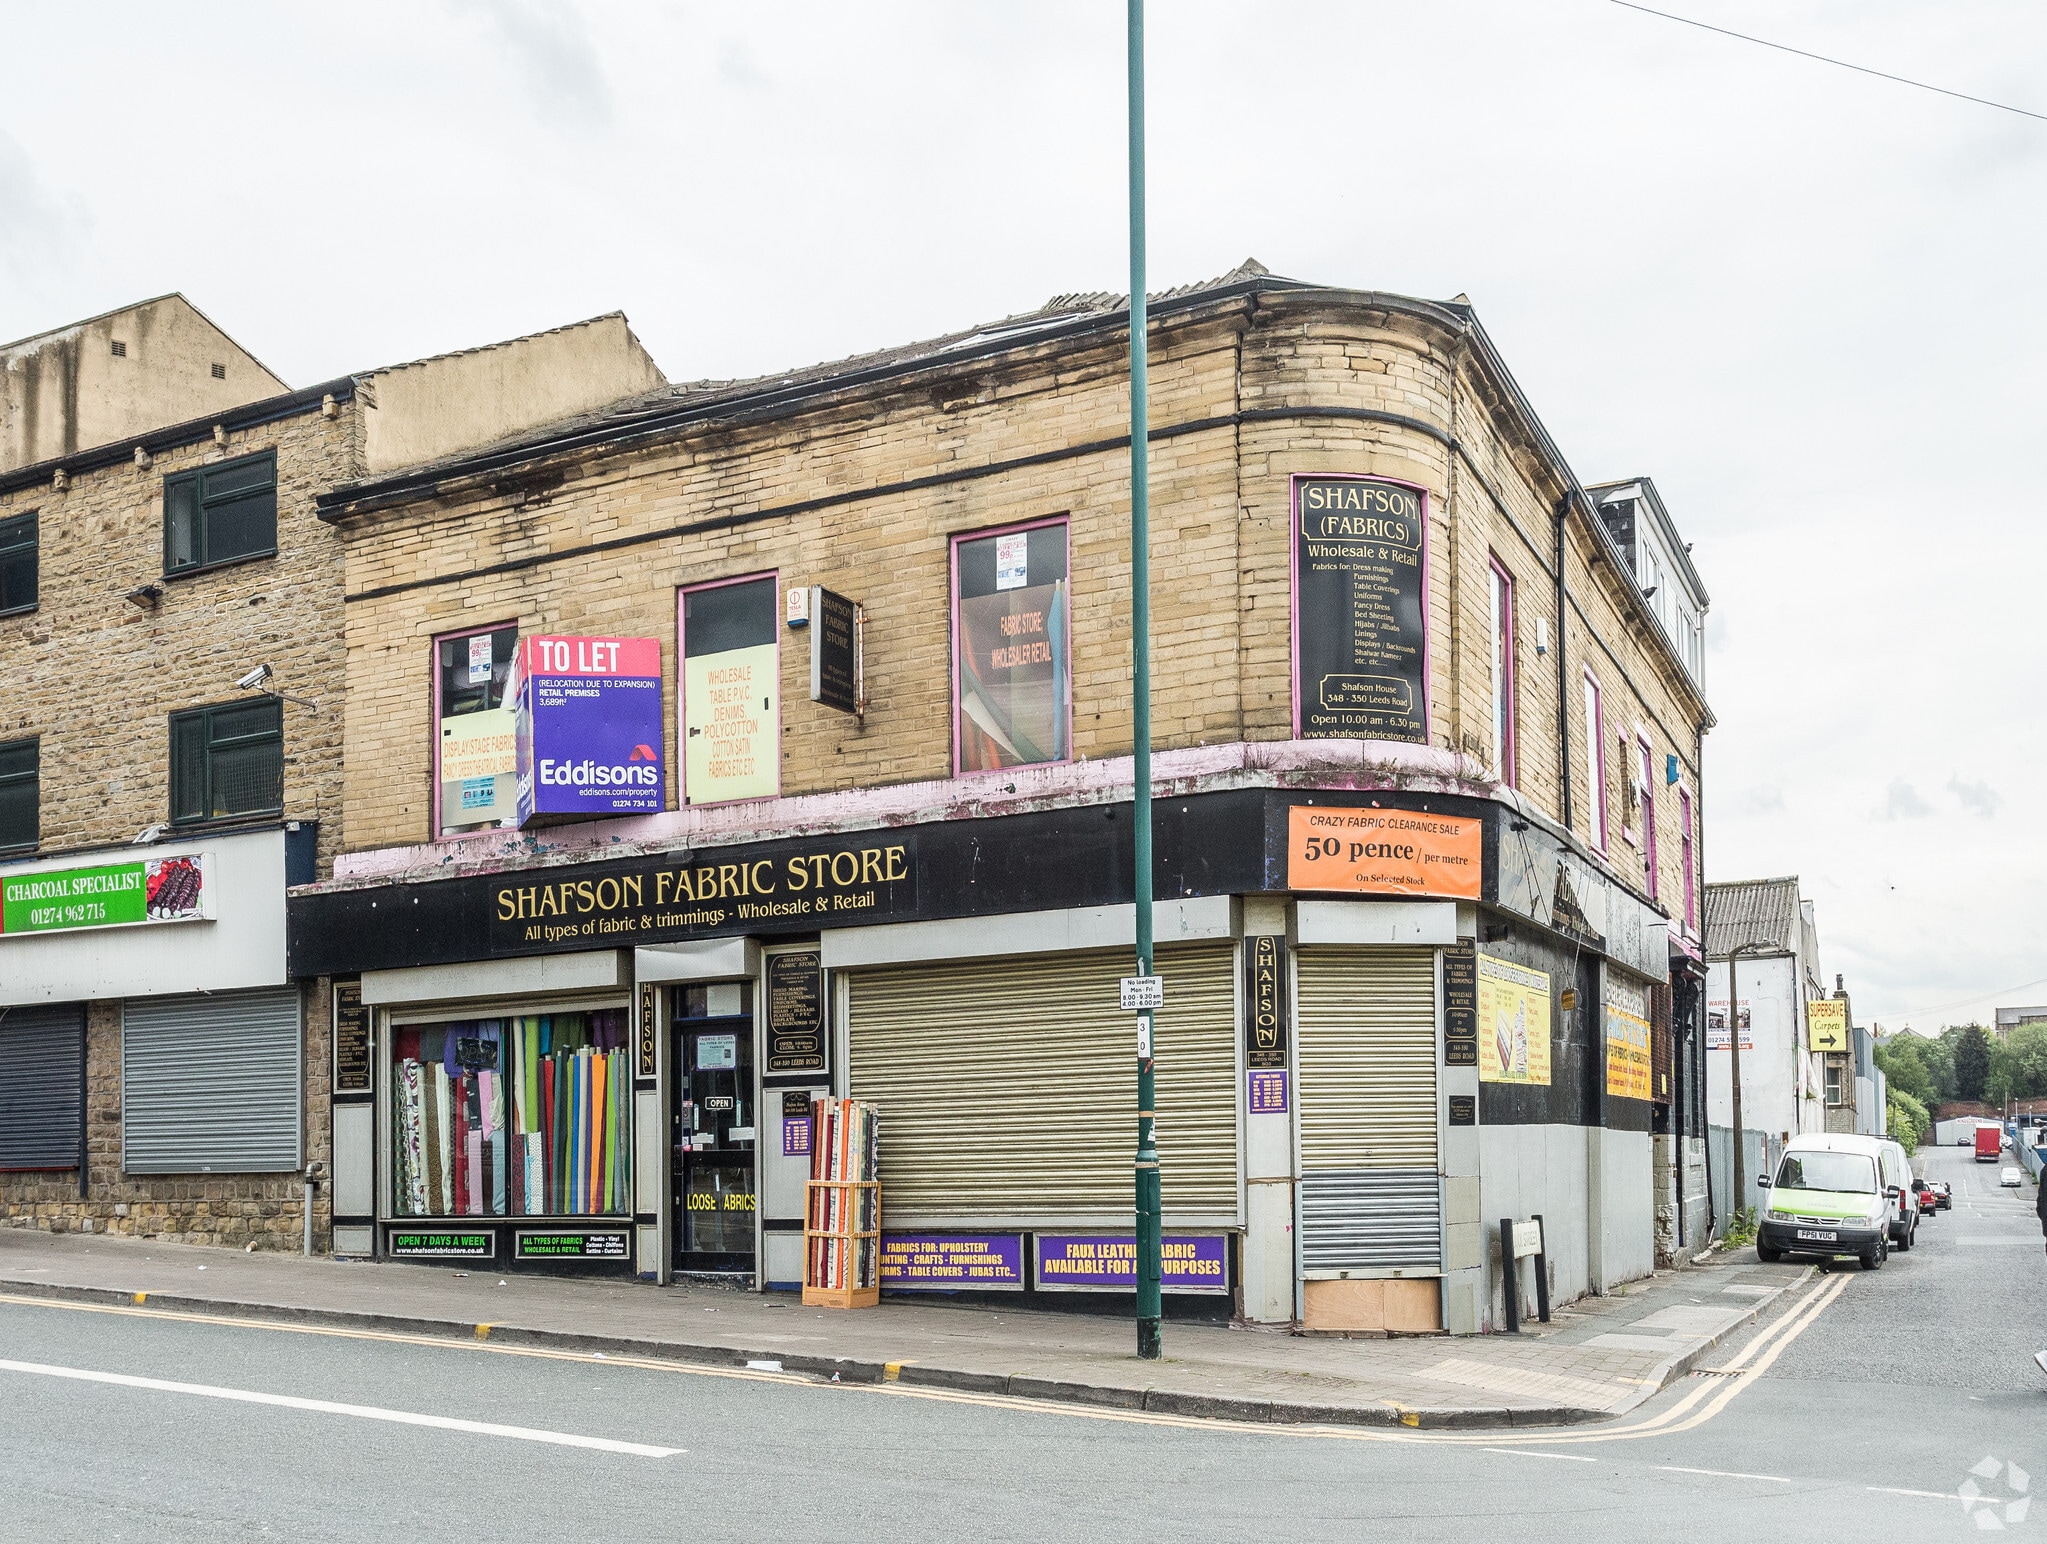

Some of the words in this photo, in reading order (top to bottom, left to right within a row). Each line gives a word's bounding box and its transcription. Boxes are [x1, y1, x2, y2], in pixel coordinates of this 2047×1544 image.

[1308, 487, 1417, 520] SHAFSON
[1320, 516, 1410, 545] (FABRICS)
[1307, 545, 1375, 559] Wholesale
[1378, 547, 1388, 560] &
[1391, 550, 1418, 567] Retail
[1352, 563, 1371, 571] Dress
[1372, 565, 1394, 576] making
[1353, 573, 1389, 583] Furnishings
[1353, 592, 1383, 601] Uniforms
[1373, 584, 1400, 595] Coverings
[821, 596, 852, 618] SHAFSON
[1354, 601, 1373, 611] Fancy
[1374, 602, 1391, 611] Dress
[825, 614, 849, 634] FABRIC
[1000, 611, 1022, 637] FABRIC
[1354, 620, 1375, 629] Hijabs
[1369, 612, 1395, 623] Sheeting
[826, 631, 849, 650] STORE
[1354, 630, 1378, 639] Linings
[1354, 639, 1381, 648] Displays
[539, 640, 570, 672] TO
[578, 641, 621, 673] LET
[1031, 641, 1052, 664] RETAIL
[707, 666, 752, 685] WHOLESALE
[538, 679, 584, 688] (RELOCATION
[586, 680, 601, 688] DUE
[603, 680, 613, 688] TO
[614, 681, 656, 689] EXPANSION)
[1341, 683, 1374, 691] Shafson
[1375, 684, 1397, 694] House
[539, 689, 563, 697] RETAIL
[565, 689, 600, 697] PREMISES
[709, 687, 732, 702] TABLE
[732, 686, 752, 701] P.V.C.
[1327, 694, 1344, 702] 348
[1369, 696, 1390, 705] Leeds
[1391, 697, 1408, 707] Road
[704, 719, 759, 740] POLYCOTTON
[1311, 714, 1337, 725] Open
[1341, 714, 1368, 724] 10.00
[1369, 717, 1383, 725] am
[1389, 716, 1408, 727] 6.30
[1408, 720, 1421, 730] pm
[1303, 728, 1427, 744] www.shafsonfabricstore.co.uk
[712, 741, 735, 760] COTTON
[735, 738, 751, 755] SATIN
[540, 759, 658, 785] Eddisons
[708, 760, 732, 779] FABRICS
[732, 759, 744, 776] ETC
[744, 757, 755, 775] ETC
[579, 788, 658, 797] eddisons.com/property
[1310, 815, 1347, 827] CRAZY
[1347, 816, 1385, 829] FABRIC
[1388, 818, 1438, 834] CLEARANCE
[1439, 824, 1460, 836] SALE
[1304, 837, 1341, 861] 50
[1348, 842, 1414, 863] pence
[1424, 853, 1440, 864] per
[1441, 855, 1469, 866] metre
[6, 880, 71, 903] CHARCOAL
[72, 871, 142, 895] SPECIALIST
[497, 874, 643, 922] SHAFSON
[655, 859, 776, 905] FABRIC
[787, 845, 908, 892] STORE
[1355, 873, 1370, 882] On
[1370, 874, 1405, 884] Selected
[1405, 876, 1426, 886] Stock
[31, 905, 63, 925] 01274
[65, 903, 86, 922] 962
[86, 902, 106, 920] 715
[525, 925, 541, 941] All
[545, 922, 578, 942] types
[581, 918, 596, 936] of
[599, 915, 637, 934] fabric
[640, 915, 653, 929] &
[656, 908, 725, 928] trimmings
[737, 897, 811, 920] Wholesale
[814, 896, 829, 912] &
[834, 891, 875, 910] Retail
[1454, 963, 1467, 971] TYPES
[1258, 939, 1275, 1041] SHAFSON
[1809, 1003, 1844, 1018] SUPERSAVE
[643, 982, 652, 1067] HAFSON
[1814, 1019, 1841, 1031] Carpets
[710, 1099, 729, 1108] OPEN
[687, 1193, 717, 1211] LOOSE
[398, 1236, 421, 1246] OPEN
[422, 1236, 428, 1246] 7
[429, 1236, 451, 1246] DAYS
[452, 1236, 459, 1246] A
[461, 1235, 486, 1246] WEEK
[523, 1237, 533, 1245] ALL
[533, 1237, 551, 1245] TYPES
[560, 1237, 583, 1245] FABRICS
[887, 1242, 920, 1253] FABRICS
[921, 1242, 938, 1253] FOR:
[939, 1242, 989, 1253] UPHOLSTERY
[1066, 1244, 1096, 1259] FAUX
[913, 1254, 943, 1265] CRAFTS
[949, 1254, 1003, 1265] FURNISHINGS
[1044, 1259, 1105, 1274] AVAILABLE
[1106, 1259, 1131, 1274] FOR
[907, 1266, 931, 1277] TABLE
[931, 1266, 963, 1277] COVERS
[968, 1266, 994, 1277] JUBAS
